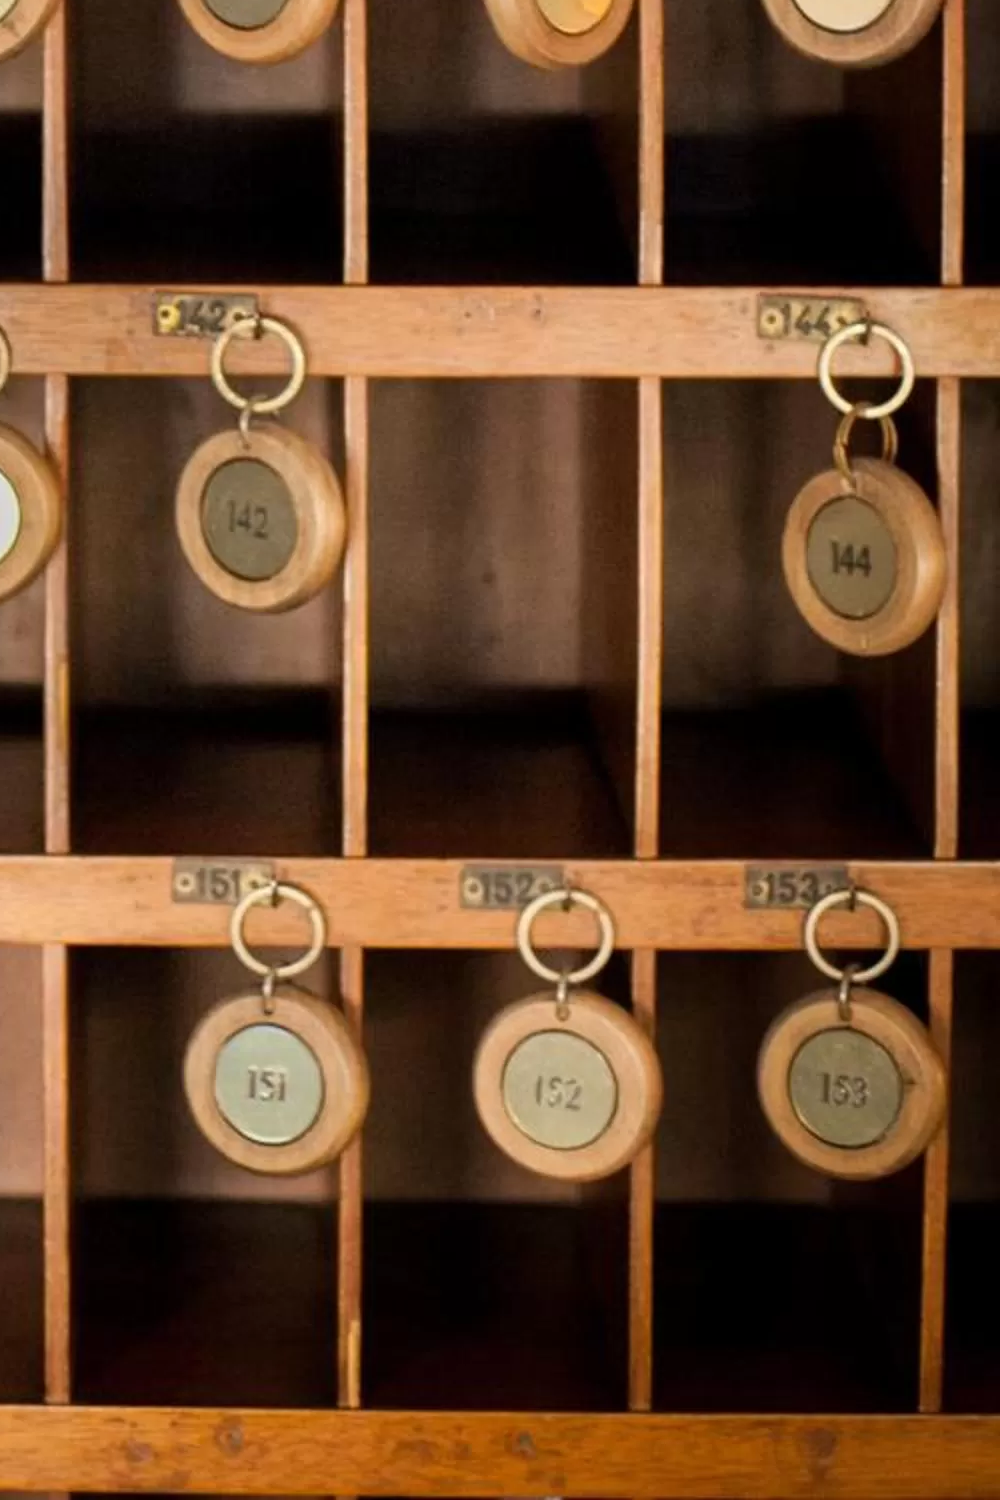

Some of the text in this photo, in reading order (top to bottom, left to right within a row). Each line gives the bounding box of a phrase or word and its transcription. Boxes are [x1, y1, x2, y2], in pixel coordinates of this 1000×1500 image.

[178, 299, 226, 333] 142
[782, 304, 830, 336] 144
[228, 499, 268, 540] 142
[830, 540, 872, 577] 144
[196, 868, 241, 899] 151
[482, 873, 534, 903] 152
[765, 873, 819, 904] 153
[248, 1069, 285, 1101] 151
[535, 1075, 581, 1111] 152
[819, 1072, 868, 1108] 153
